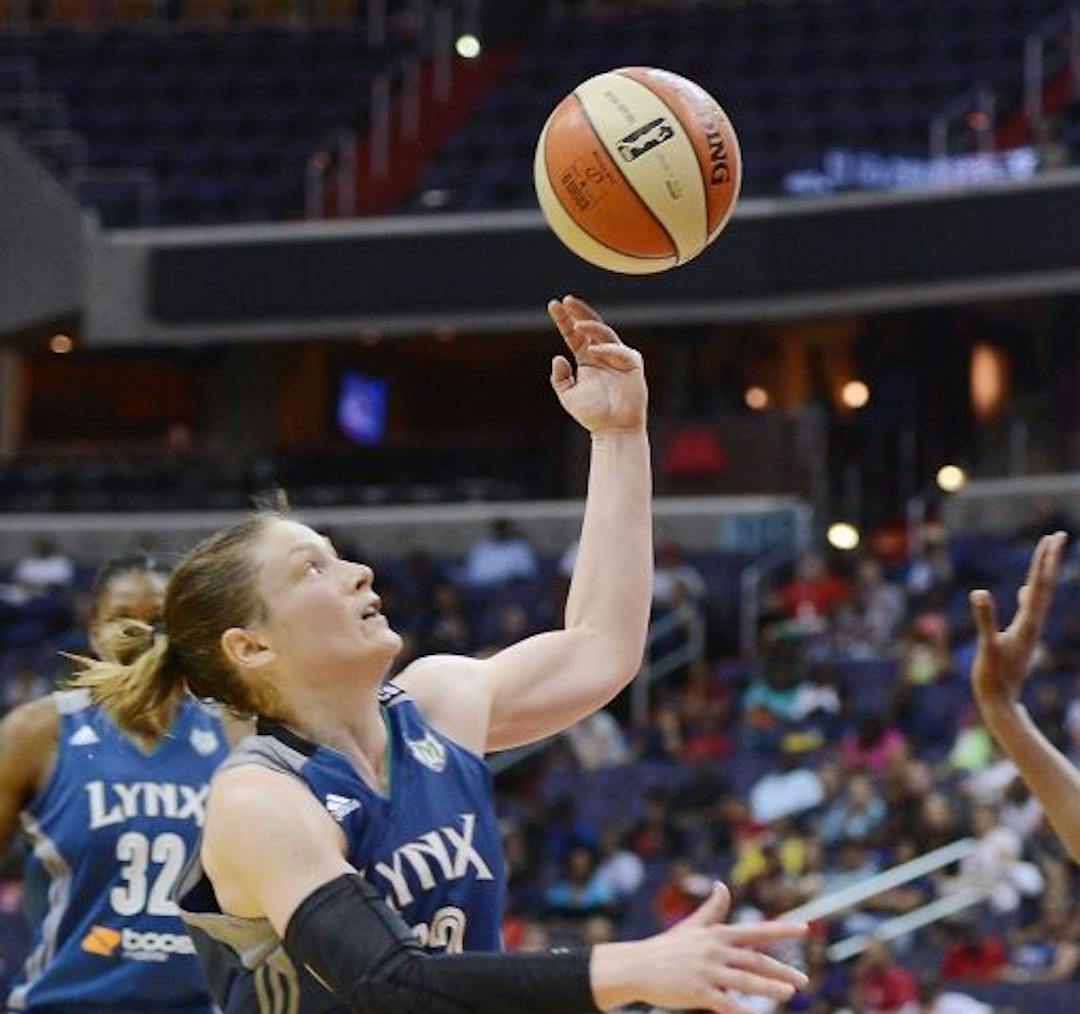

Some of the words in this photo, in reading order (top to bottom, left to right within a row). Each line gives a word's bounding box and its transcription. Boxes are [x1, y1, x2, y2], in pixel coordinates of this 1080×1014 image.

[85, 780, 209, 830] LYNX
[110, 831, 187, 916] 32
[374, 812, 496, 911] YNX
